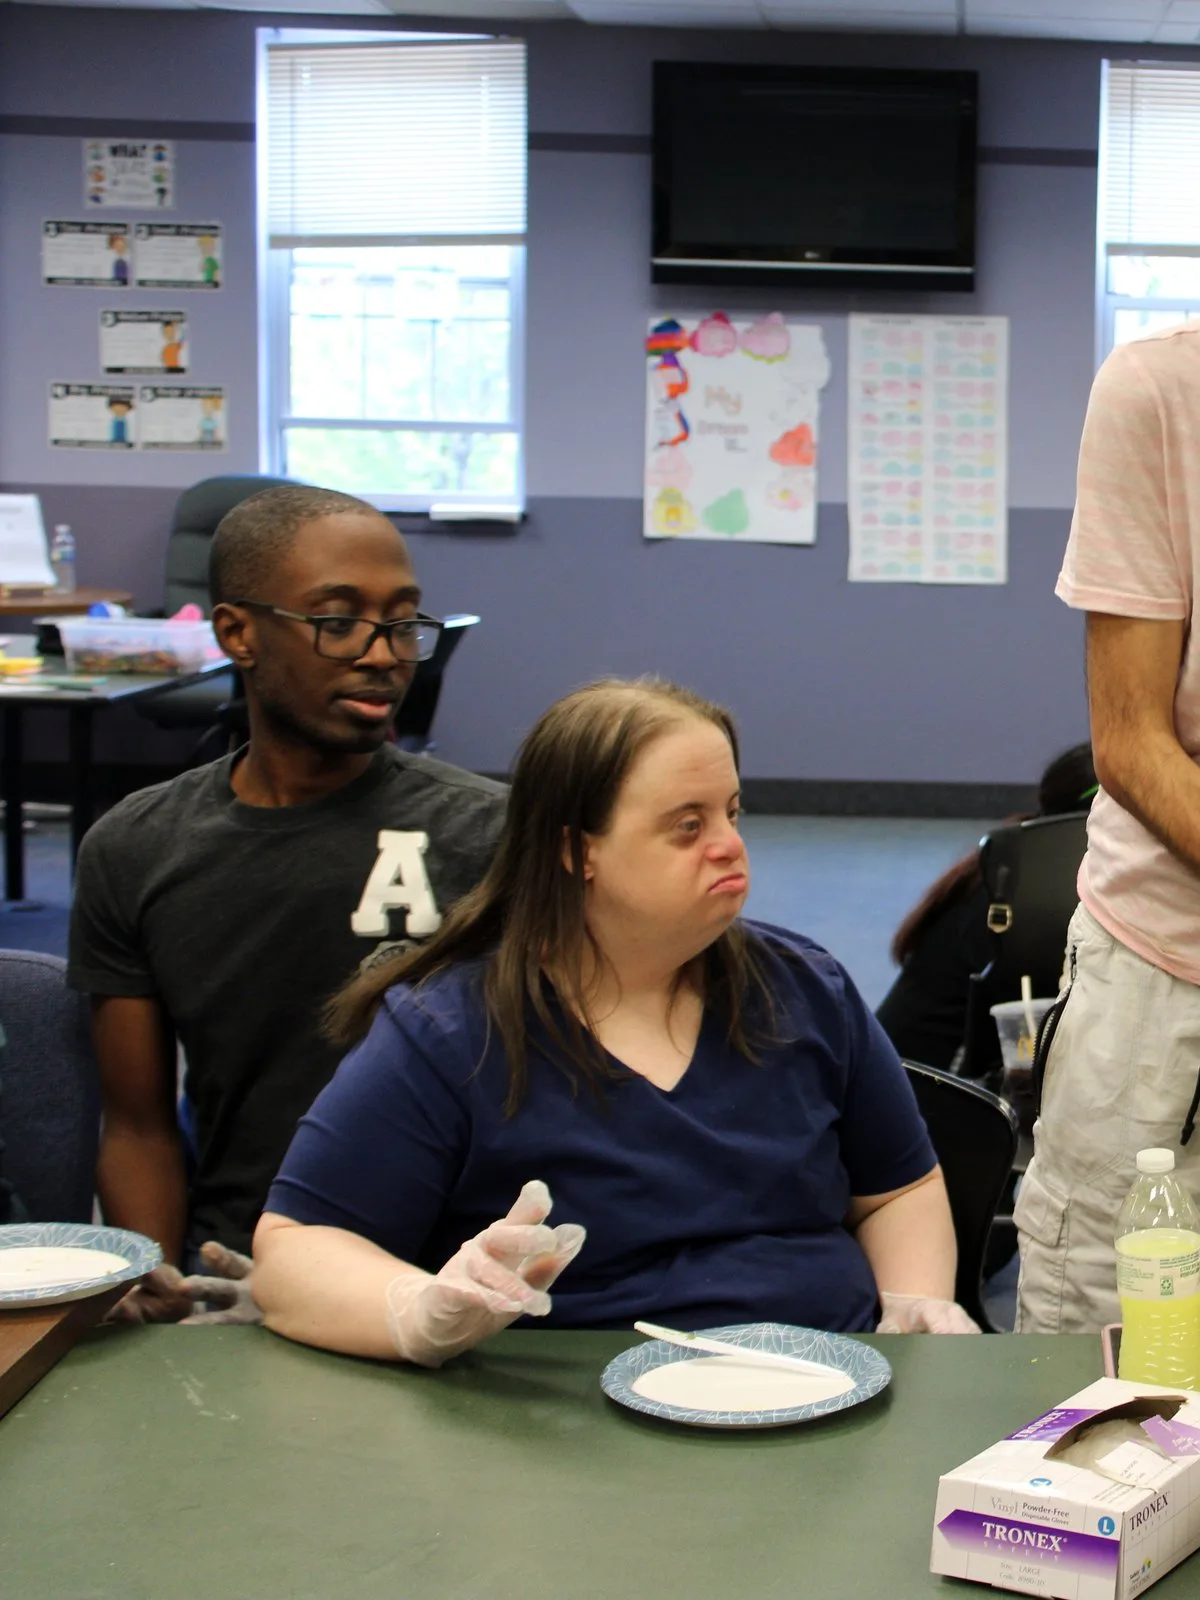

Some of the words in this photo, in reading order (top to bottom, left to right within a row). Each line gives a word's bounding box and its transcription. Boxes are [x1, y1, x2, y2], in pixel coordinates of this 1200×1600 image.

[350, 828, 443, 938] A
[991, 1497, 1018, 1515] Vinyl
[1022, 1502, 1070, 1518] Powder-Free
[1130, 1493, 1168, 1531] TRONEX
[982, 1522, 1063, 1552] TRONEX
